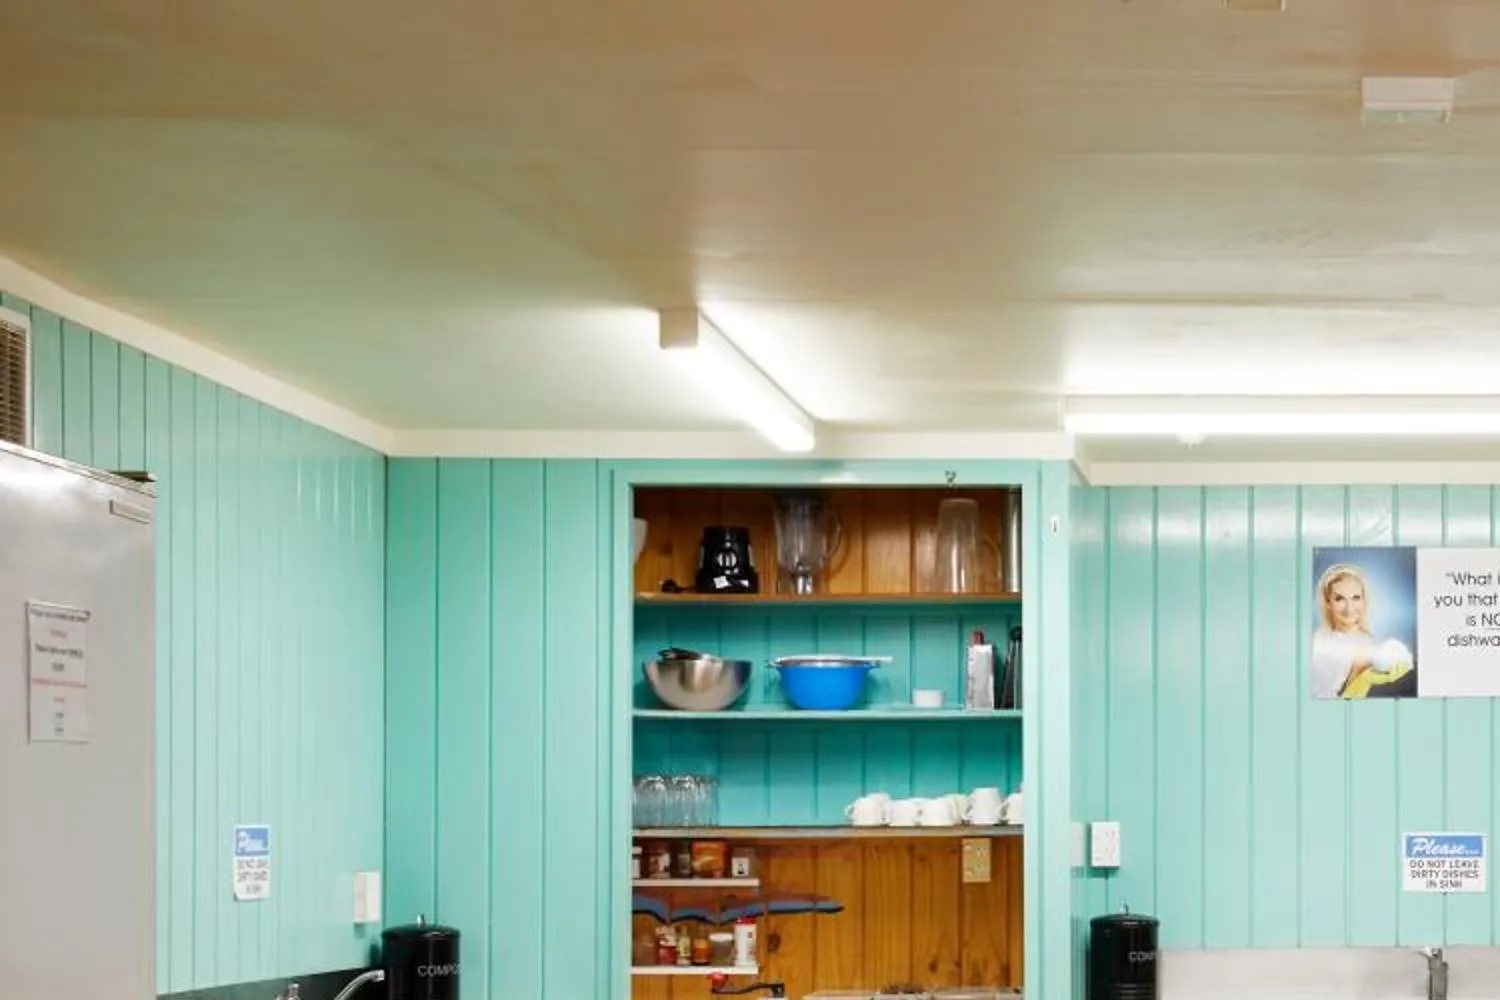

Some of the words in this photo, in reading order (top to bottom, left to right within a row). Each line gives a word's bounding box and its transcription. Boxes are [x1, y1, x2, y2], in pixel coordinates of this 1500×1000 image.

[1446, 571, 1493, 585] "What
[1434, 595, 1463, 608] you
[1467, 591, 1498, 606] that
[1466, 612, 1477, 626] is
[1409, 860, 1425, 869] DO
[1427, 860, 1446, 869] NOT
[1449, 860, 1480, 869] LEAVE
[1411, 870, 1440, 878] DIRTY
[1442, 870, 1479, 878] DISHES
[1439, 880, 1463, 888] SINK
